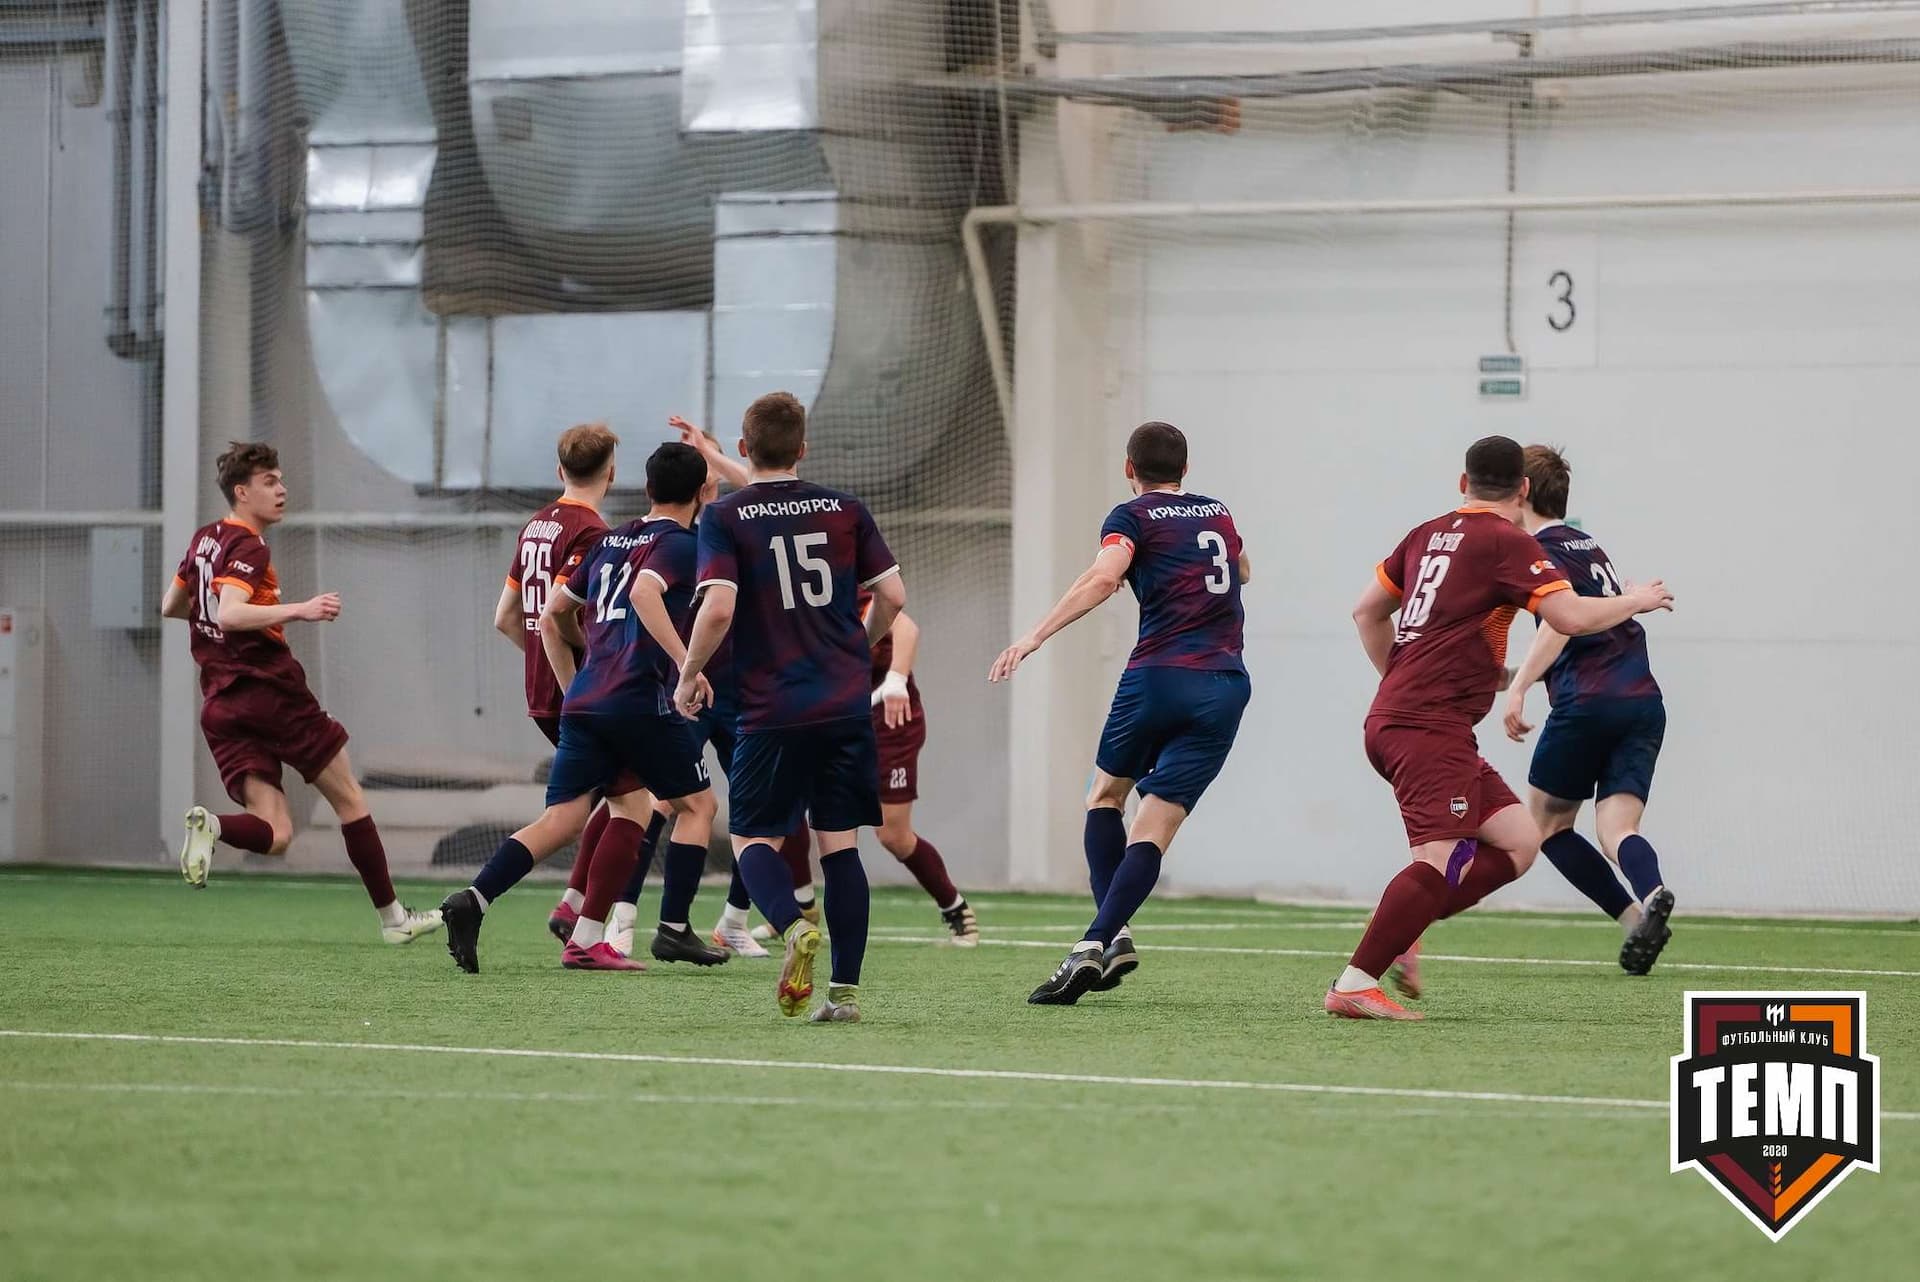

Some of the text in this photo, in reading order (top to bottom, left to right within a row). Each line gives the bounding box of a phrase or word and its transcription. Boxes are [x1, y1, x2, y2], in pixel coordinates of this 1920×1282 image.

[1548, 271, 1575, 331] 3
[737, 498, 842, 520] КРАСНОЯРСК
[520, 541, 552, 614] 25
[596, 561, 632, 624] 12
[769, 532, 833, 610] 15
[1197, 531, 1231, 594] 3
[1400, 554, 1450, 630] 13
[695, 759, 709, 782] 12
[890, 768, 908, 788] 22
